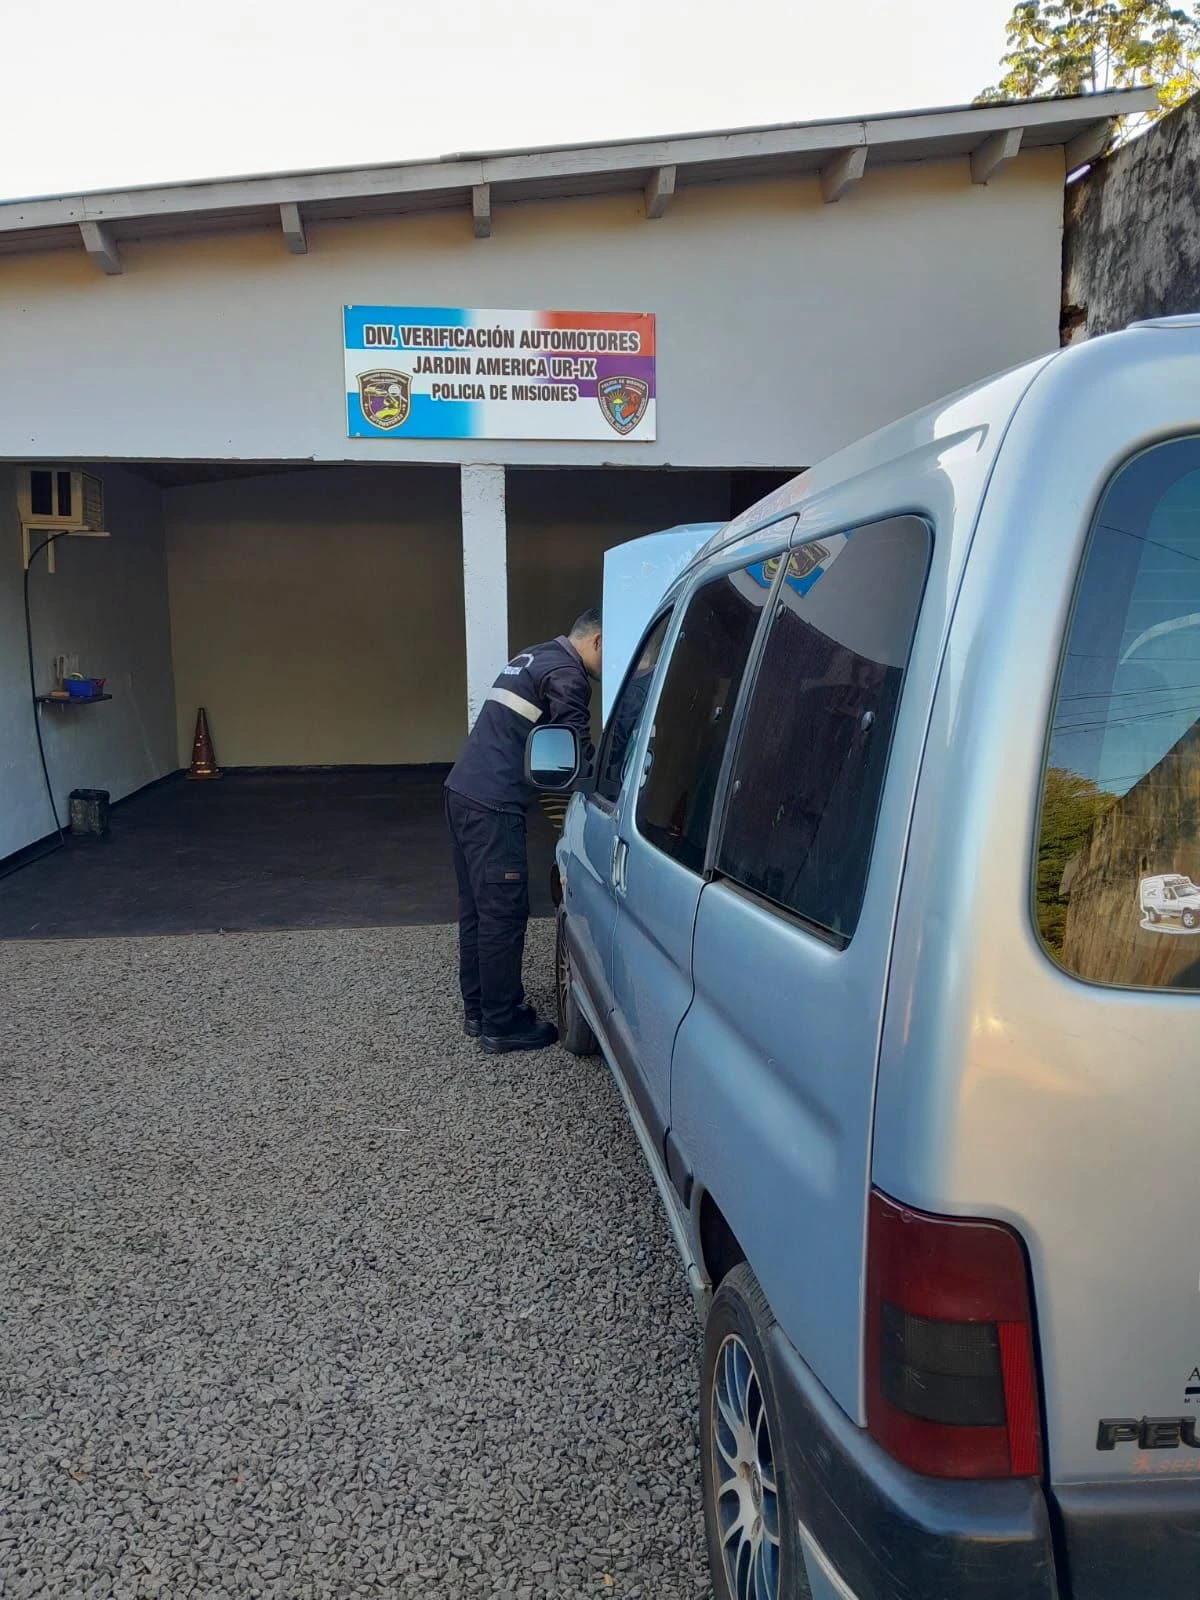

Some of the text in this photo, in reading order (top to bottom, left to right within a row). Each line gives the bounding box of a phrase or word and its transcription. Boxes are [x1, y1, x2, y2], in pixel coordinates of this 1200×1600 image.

[365, 325, 640, 352] DIV. VERIFICACIÓN AUTOMOTORES
[412, 356, 596, 378] JARDIN AMERICA UR-IX
[432, 383, 577, 402] POLICIA DE MISIONES
